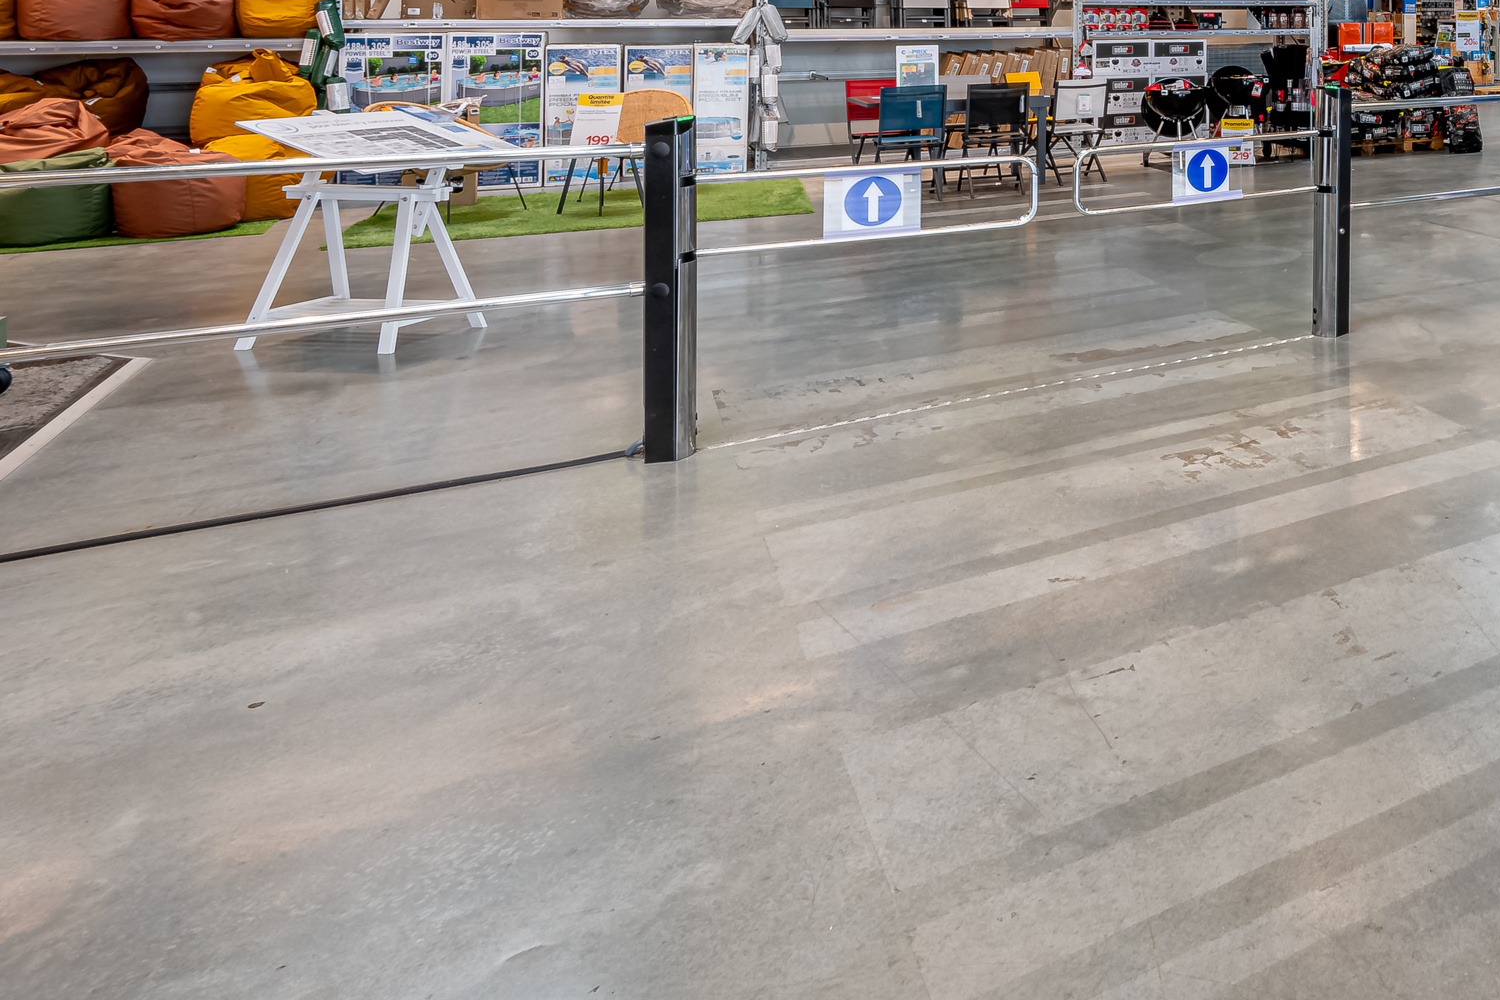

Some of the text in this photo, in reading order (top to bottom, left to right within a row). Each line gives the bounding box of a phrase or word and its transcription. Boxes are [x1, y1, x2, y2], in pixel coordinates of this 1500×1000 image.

[499, 36, 541, 46] Bestway
[1113, 46, 1128, 54] weber
[1223, 120, 1251, 128] Promotion
